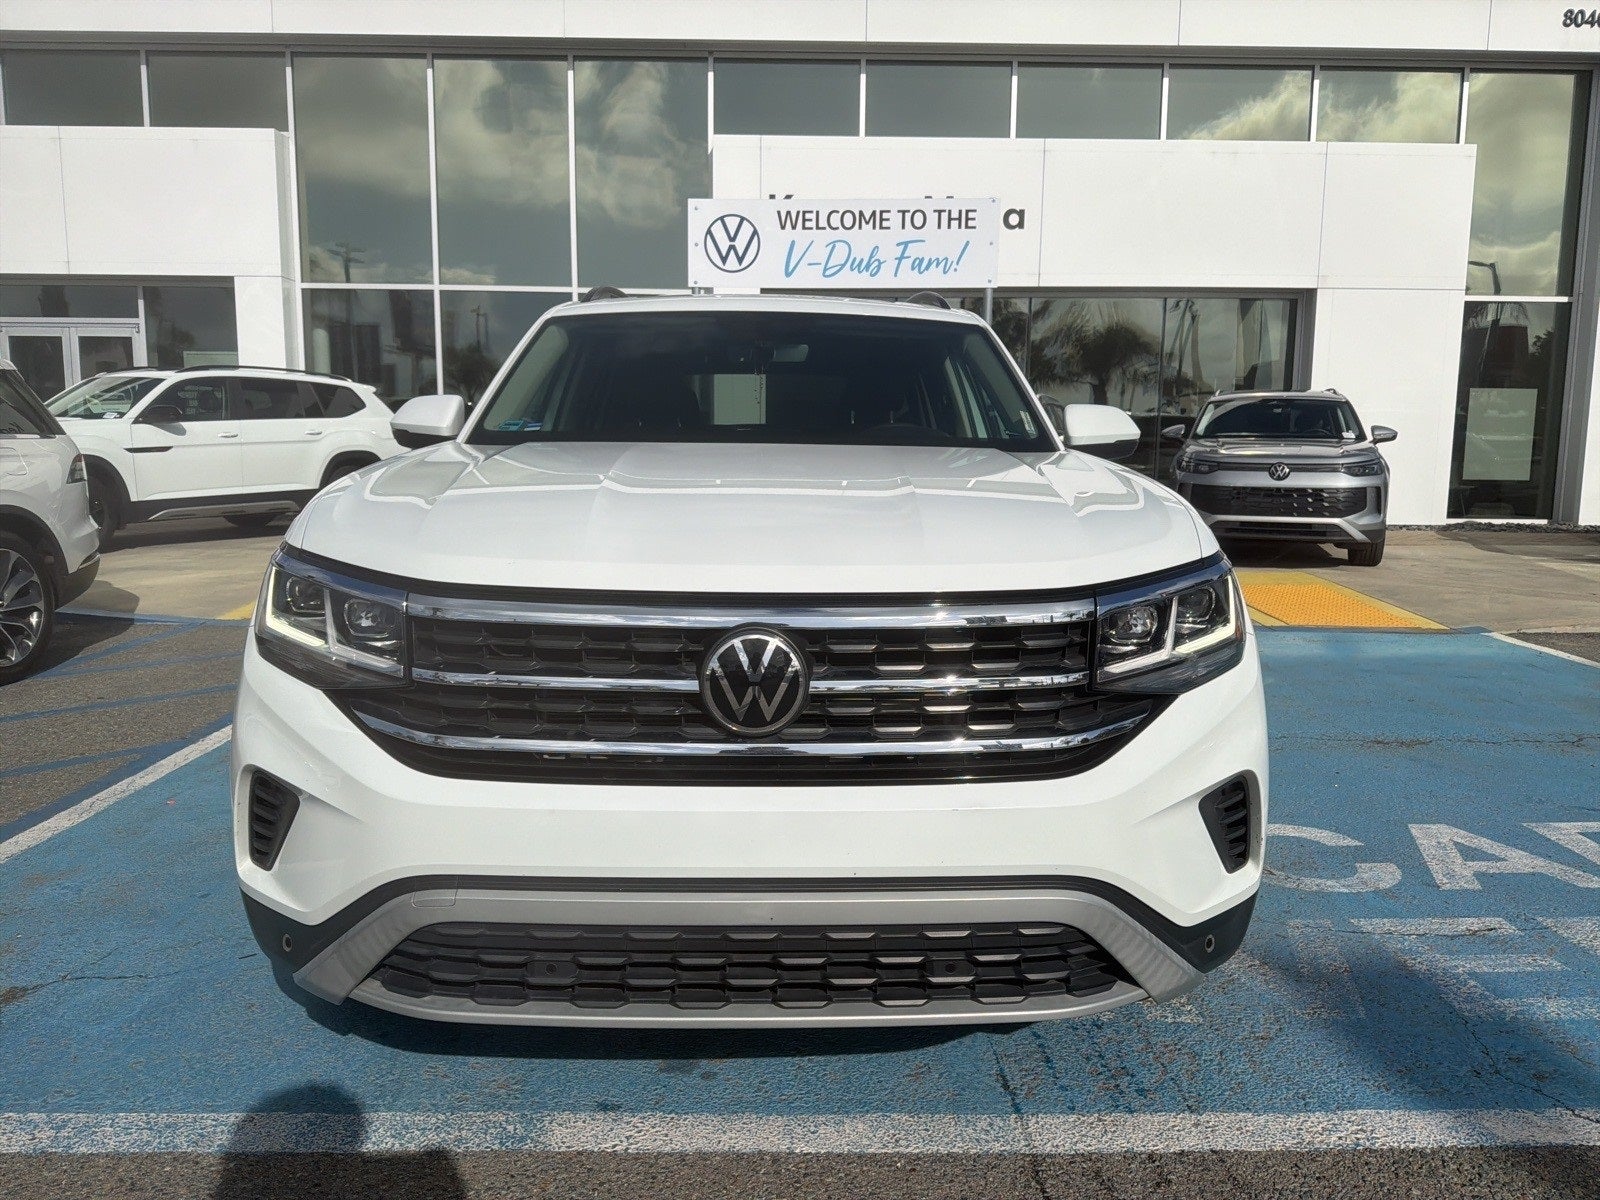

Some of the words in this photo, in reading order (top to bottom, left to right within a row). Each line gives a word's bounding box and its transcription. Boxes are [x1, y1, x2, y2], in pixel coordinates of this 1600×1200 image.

[1562, 8, 1600, 29] 804
[776, 209, 891, 231] WELCOME
[897, 209, 927, 231] TO
[933, 209, 977, 230] THE
[784, 239, 886, 278] V-Dub
[894, 239, 970, 277] Fam!
[703, 628, 807, 734] VW
